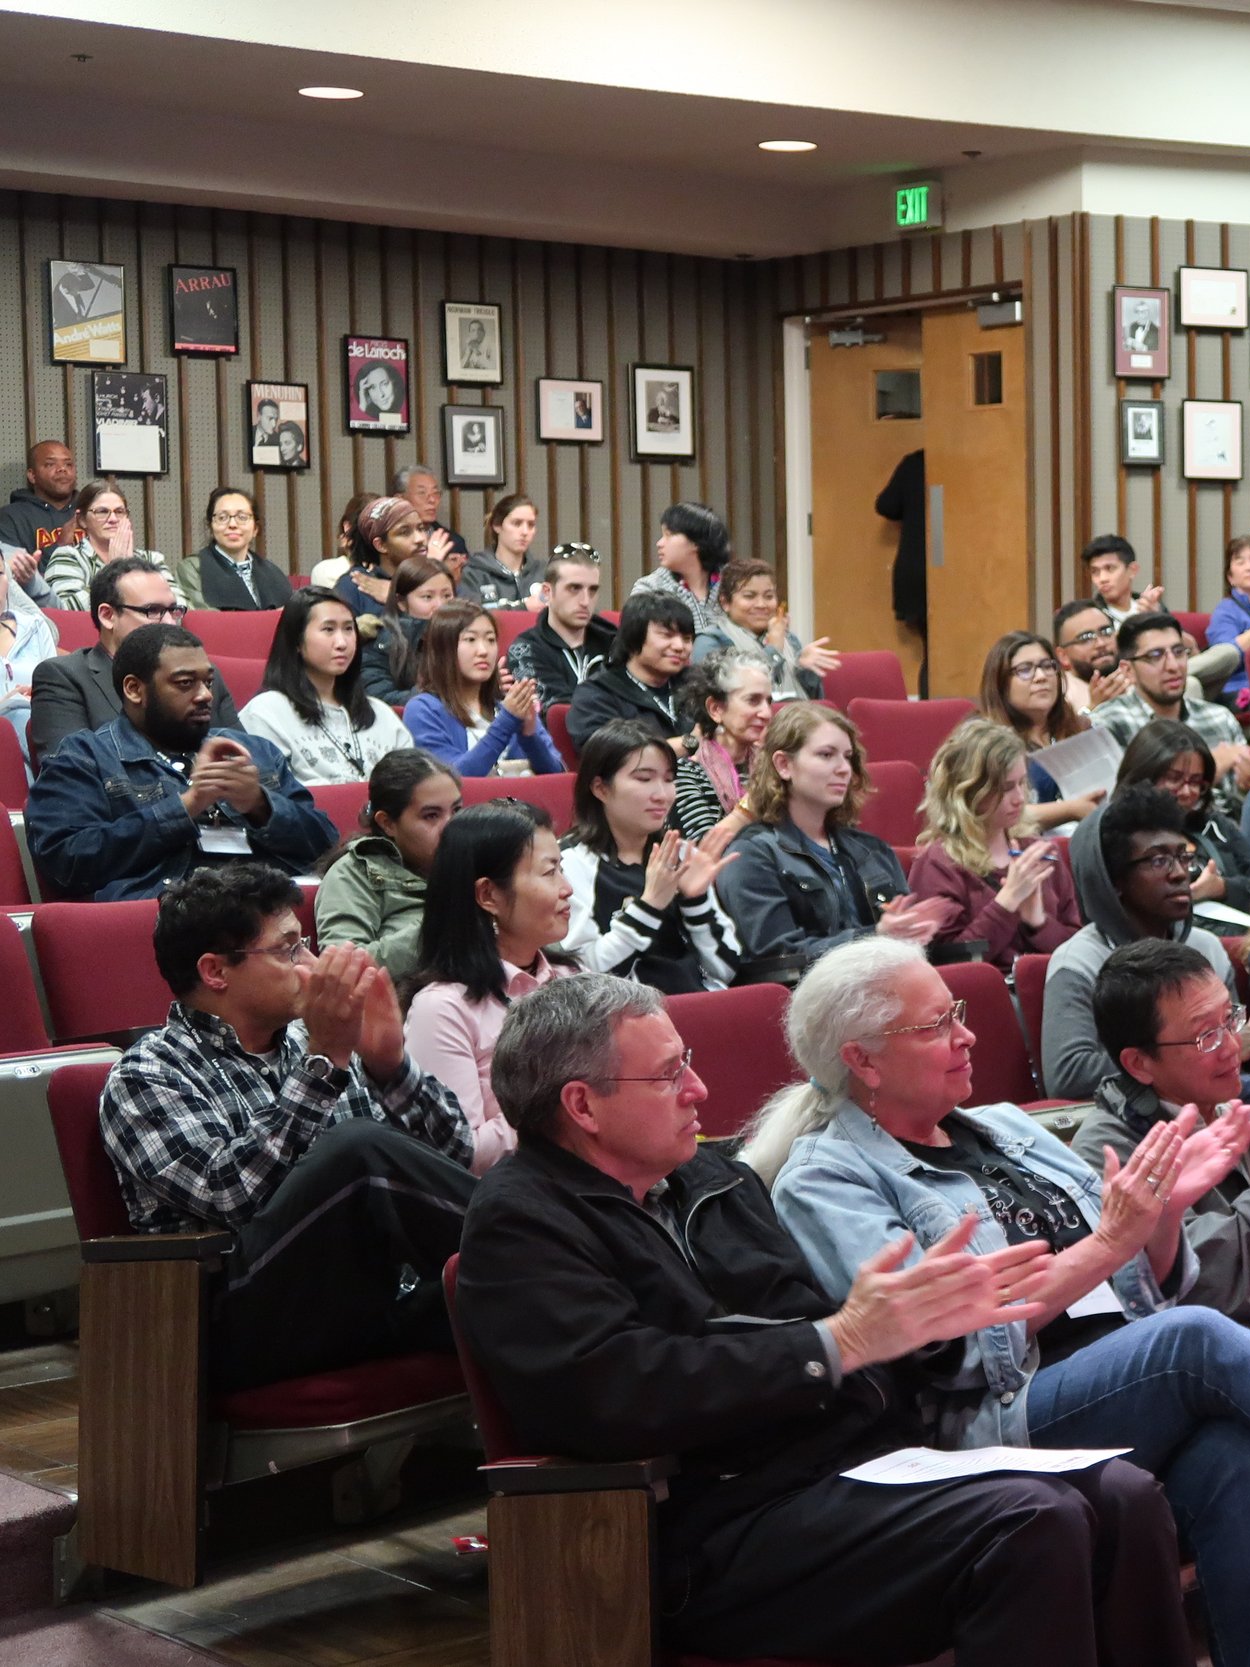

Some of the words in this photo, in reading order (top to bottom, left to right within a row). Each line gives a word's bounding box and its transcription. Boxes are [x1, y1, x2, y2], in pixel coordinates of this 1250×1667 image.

[897, 186, 929, 225] EXIT
[176, 273, 232, 294] ARRAU
[365, 343, 406, 360] Larroch
[254, 384, 303, 400] MENUHIN
[191, 1028, 203, 1044] Group
[211, 1058, 220, 1069] Los
